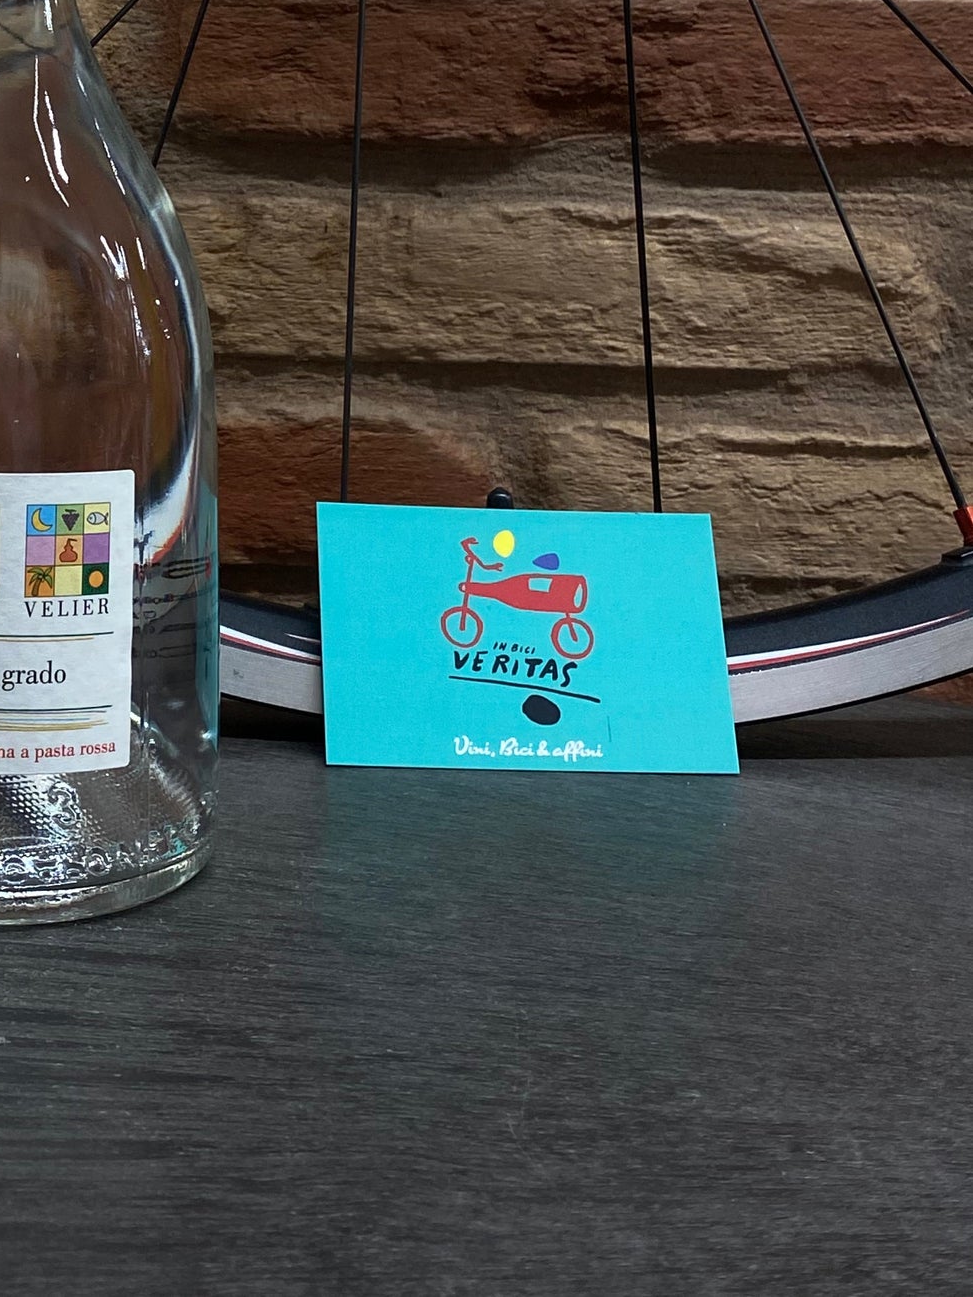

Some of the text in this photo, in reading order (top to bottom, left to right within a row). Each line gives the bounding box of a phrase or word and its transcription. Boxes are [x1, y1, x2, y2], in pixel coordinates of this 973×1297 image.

[24, 597, 110, 619] VELIER
[492, 641, 536, 655] IN BICI
[1, 659, 67, 692] grado
[453, 650, 579, 688] VERITAS
[21, 746, 30, 758] a
[34, 743, 75, 763] pasta
[79, 740, 116, 755] rossa
[453, 734, 604, 763] Vini, Bici & affini
